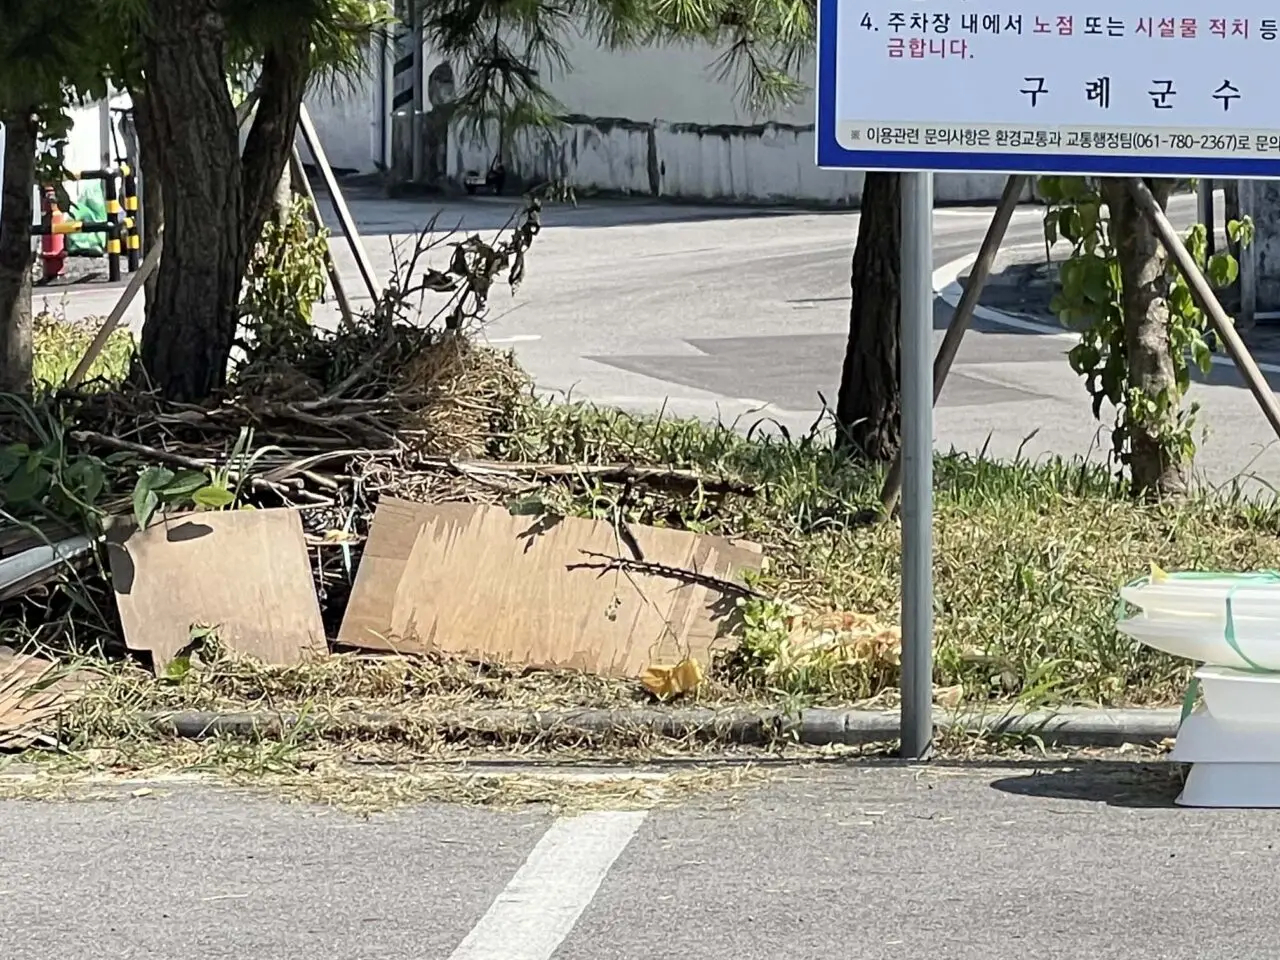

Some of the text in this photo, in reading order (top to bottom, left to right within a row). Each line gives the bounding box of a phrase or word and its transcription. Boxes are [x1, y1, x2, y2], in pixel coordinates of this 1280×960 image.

[859, 11, 879, 32] 4.
[886, 12, 951, 34] 주차장
[960, 13, 1023, 36] 내에서
[1032, 15, 1073, 36] 노점
[1083, 15, 1126, 38] 또는
[1134, 16, 1198, 39] 시설물
[1208, 18, 1249, 40] 적치
[1259, 19, 1279, 41] 등
[886, 37, 974, 61] 금합니다.
[866, 126, 920, 145] 이용관련
[923, 128, 992, 147] 문의사항은
[994, 129, 1063, 149] 환경교통과
